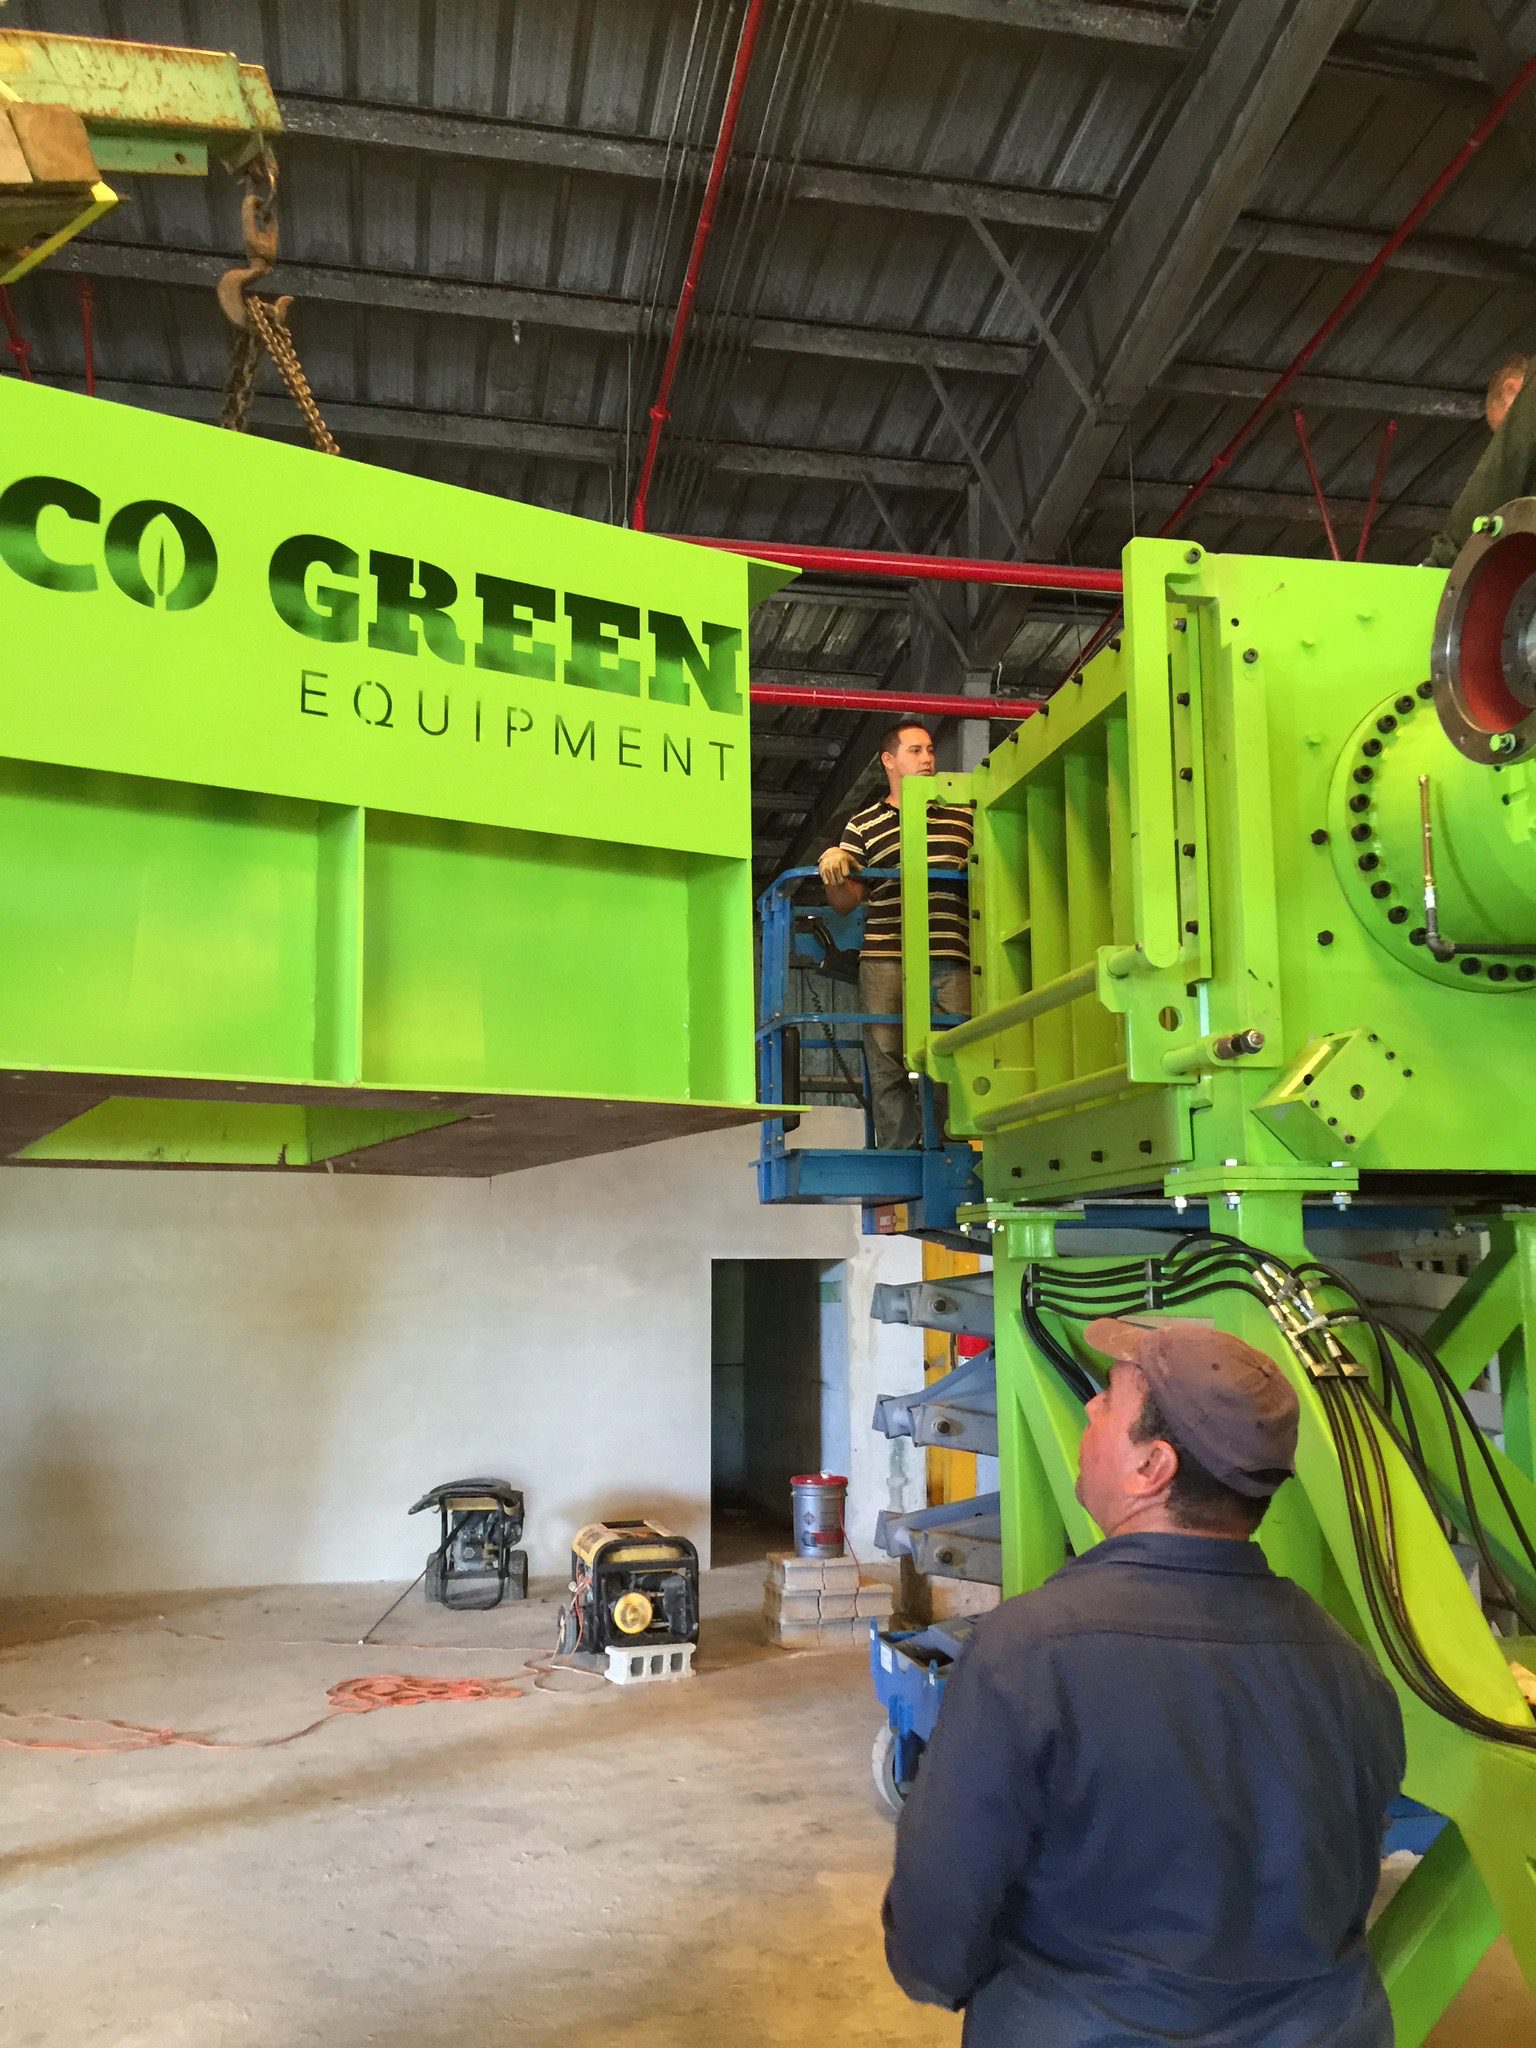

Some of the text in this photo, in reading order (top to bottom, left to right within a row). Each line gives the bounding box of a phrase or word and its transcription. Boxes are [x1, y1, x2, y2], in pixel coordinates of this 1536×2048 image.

[0, 475, 744, 716] CO GREEN
[300, 669, 735, 782] EQUIPMENT
